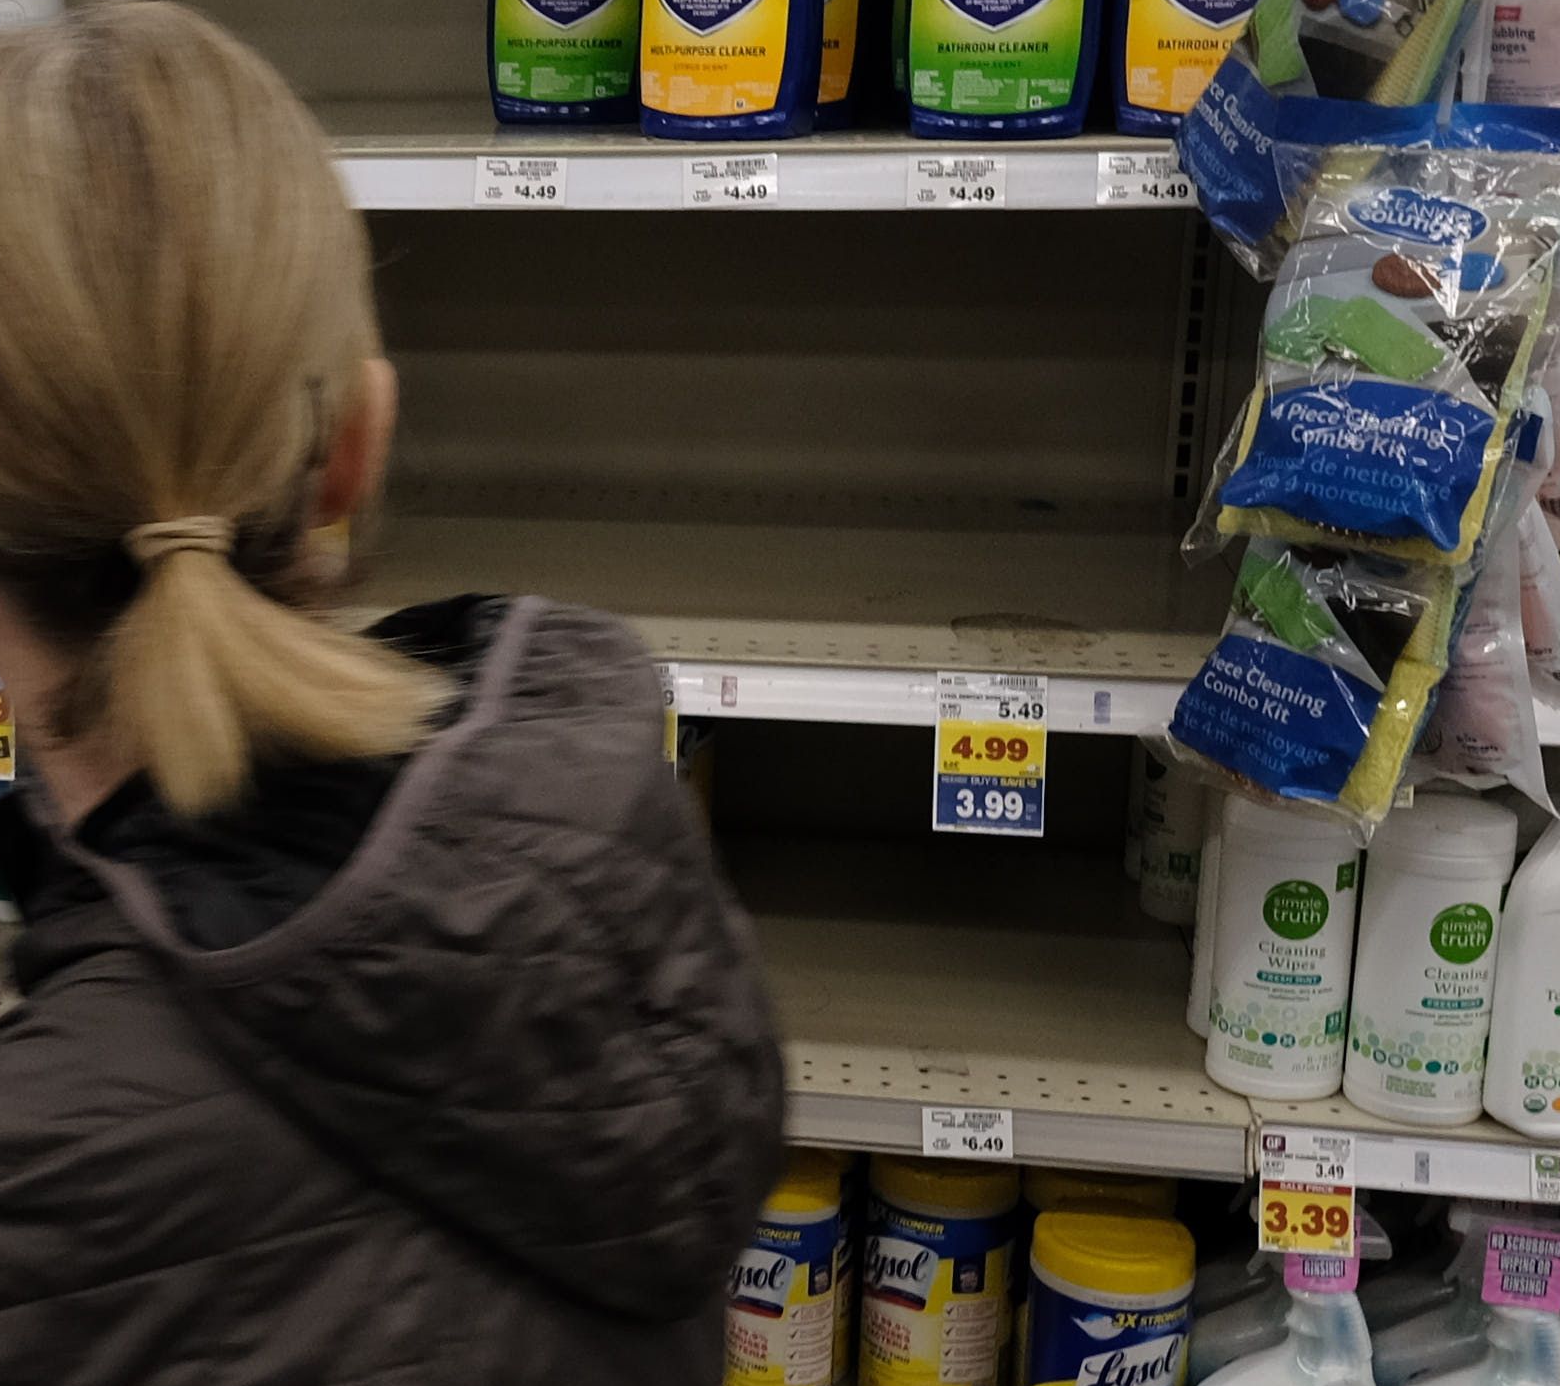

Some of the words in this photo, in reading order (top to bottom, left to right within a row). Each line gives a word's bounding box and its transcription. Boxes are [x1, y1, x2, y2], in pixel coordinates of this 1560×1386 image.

[949, 185, 995, 202] $4.49
[1142, 183, 1188, 200] $4.49
[1203, 671, 1260, 711] Combo
[1262, 698, 1291, 725] Kit
[1246, 660, 1328, 719] Cleaning
[997, 701, 1045, 721] 5.49
[950, 734, 1029, 764] 4.99
[956, 789, 1025, 823] 3.99
[1272, 905, 1323, 925] truth
[1439, 930, 1488, 948] truth
[1258, 940, 1326, 960] Cleaning
[1268, 956, 1317, 971] Wipes
[1434, 980, 1480, 996] Wipes
[1264, 1201, 1350, 1239] 3.39
